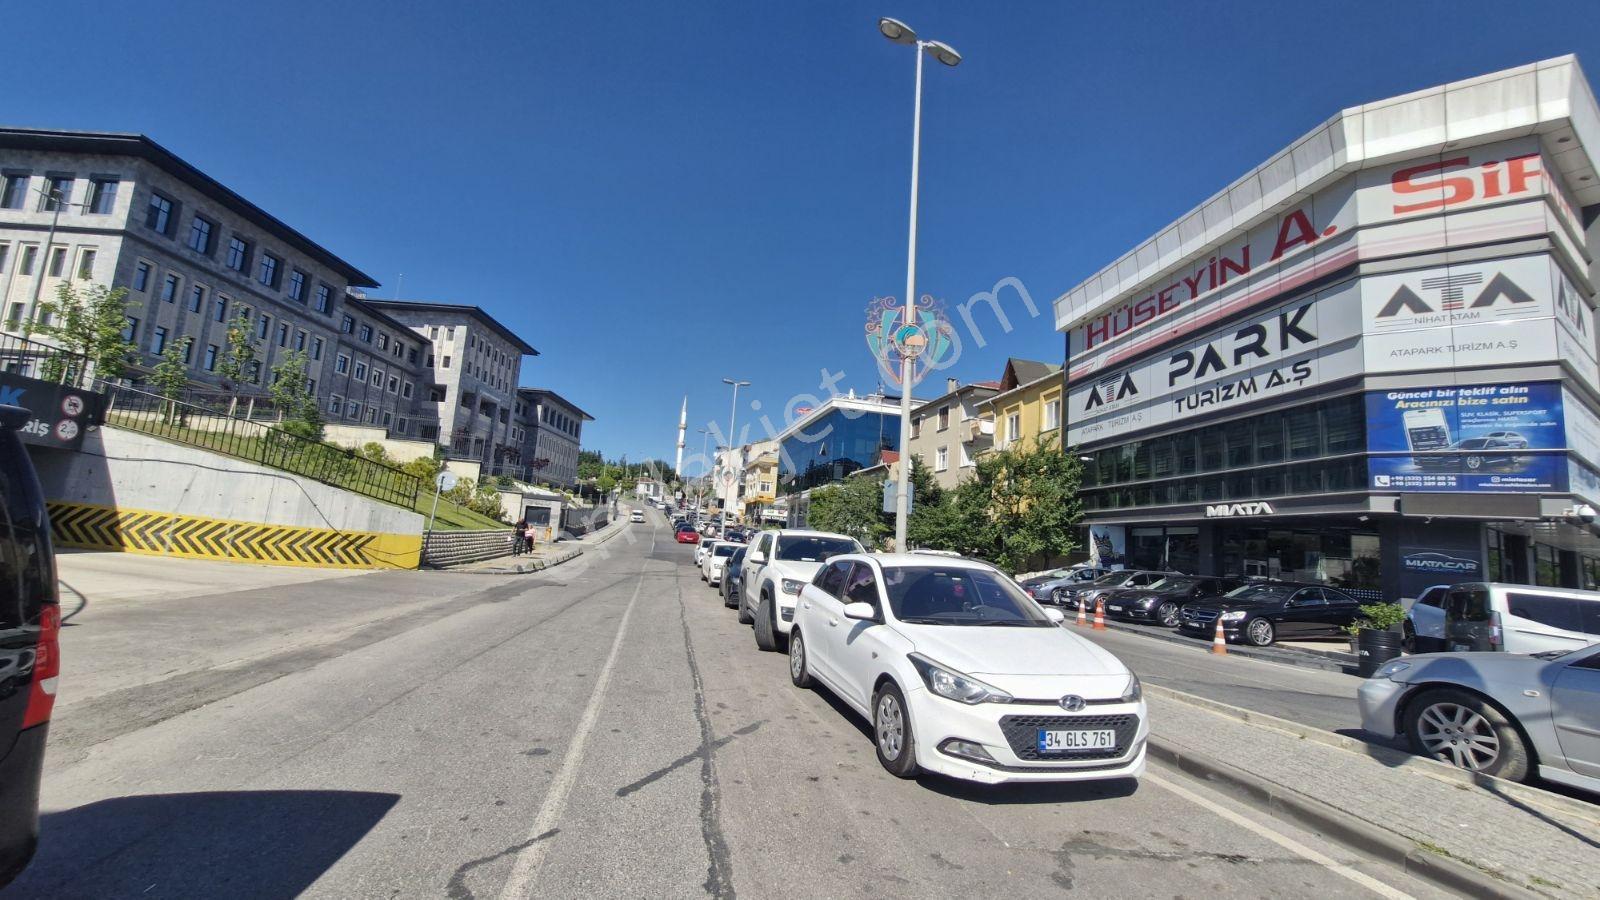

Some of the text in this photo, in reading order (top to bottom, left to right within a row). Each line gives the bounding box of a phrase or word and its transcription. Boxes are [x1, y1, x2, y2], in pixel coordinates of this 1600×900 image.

[1086, 208, 1338, 351] HÜSEYİN A.
[1376, 271, 1536, 318] ATA
[1414, 311, 1481, 325] NİHAT ATAM
[1168, 301, 1319, 388] PARK
[1390, 346, 1443, 358] ATAPARK
[1446, 340, 1494, 353] TURİZM
[1084, 370, 1139, 411] ATA
[1174, 358, 1312, 413] TURİZM A.Ş
[1387, 391, 1432, 400] Güncel
[1436, 389, 1456, 398] bir
[1459, 387, 1497, 397] teklif
[1395, 395, 1529, 409] Aracınızı bize satın
[1206, 501, 1274, 517] MIATA
[1405, 559, 1477, 570] MIATACAR
[1046, 731, 1112, 747] 34 GLS 761
